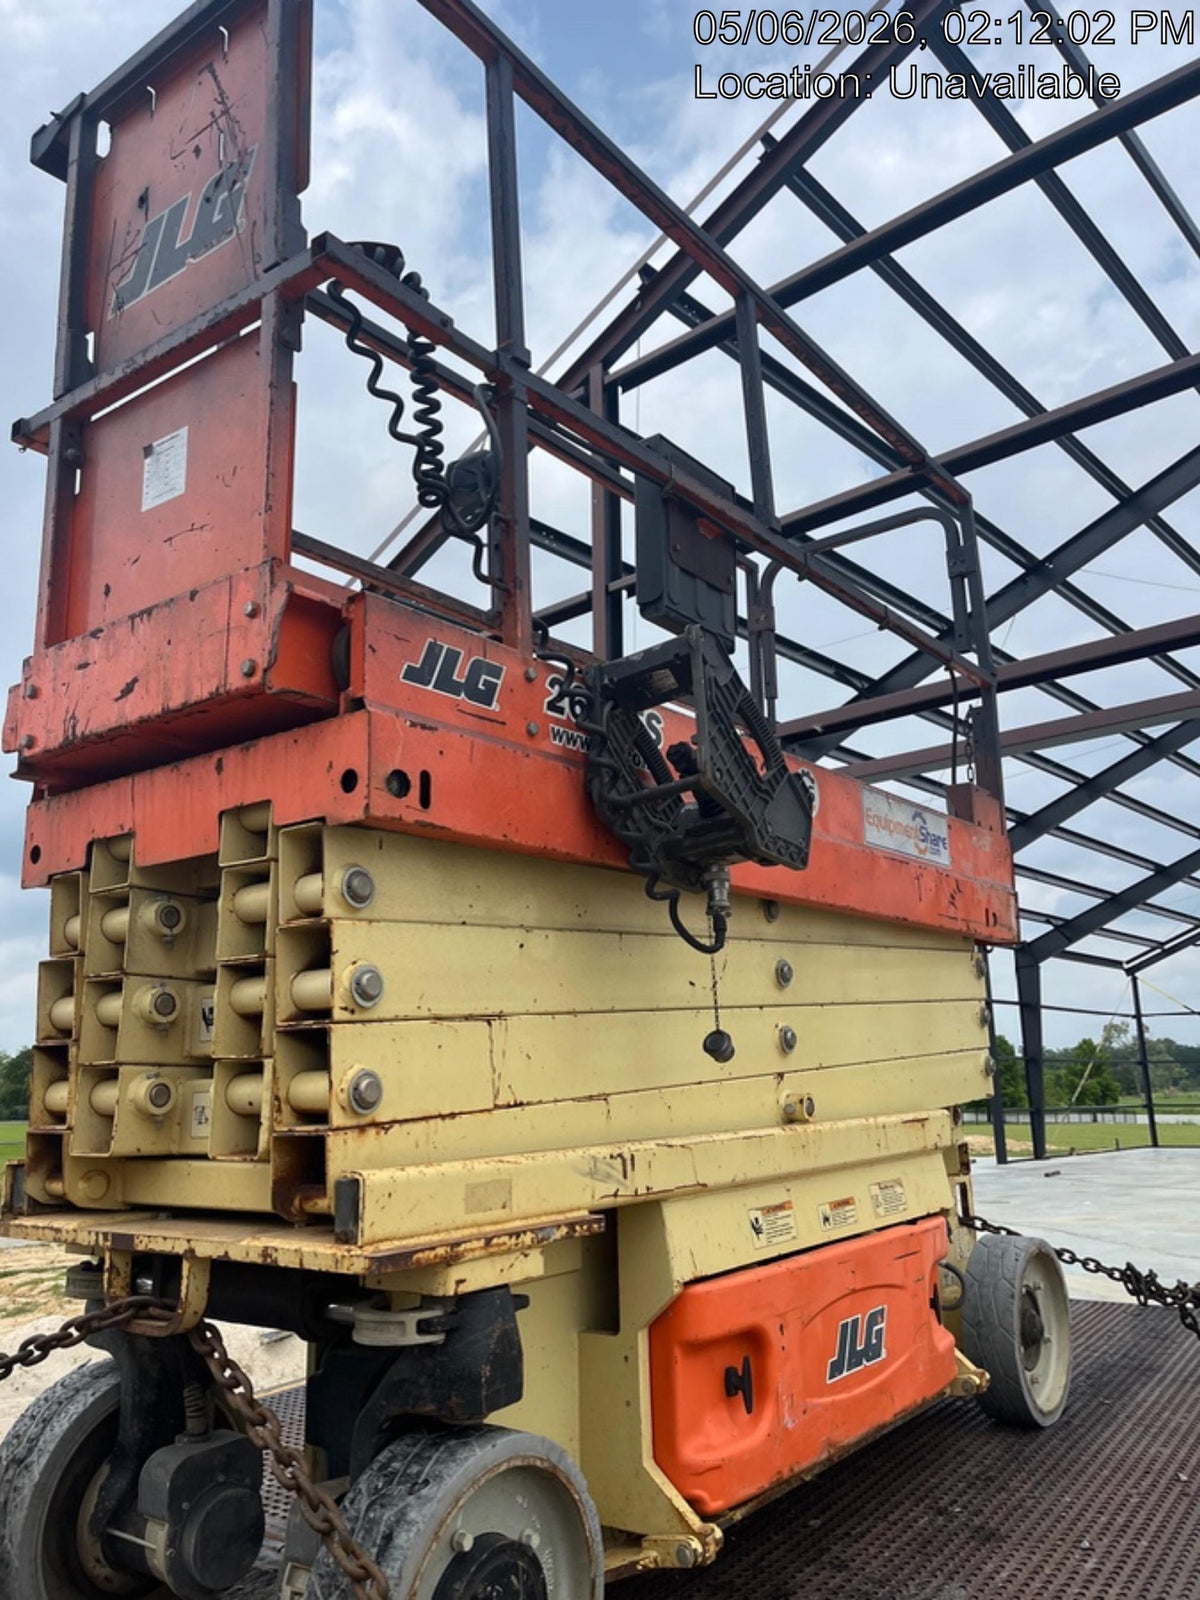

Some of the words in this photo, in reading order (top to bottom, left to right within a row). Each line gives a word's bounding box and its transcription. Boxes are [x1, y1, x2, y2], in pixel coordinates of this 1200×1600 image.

[107, 144, 258, 320] JLG
[400, 638, 506, 711] JLG
[826, 1304, 888, 1385] JLG
